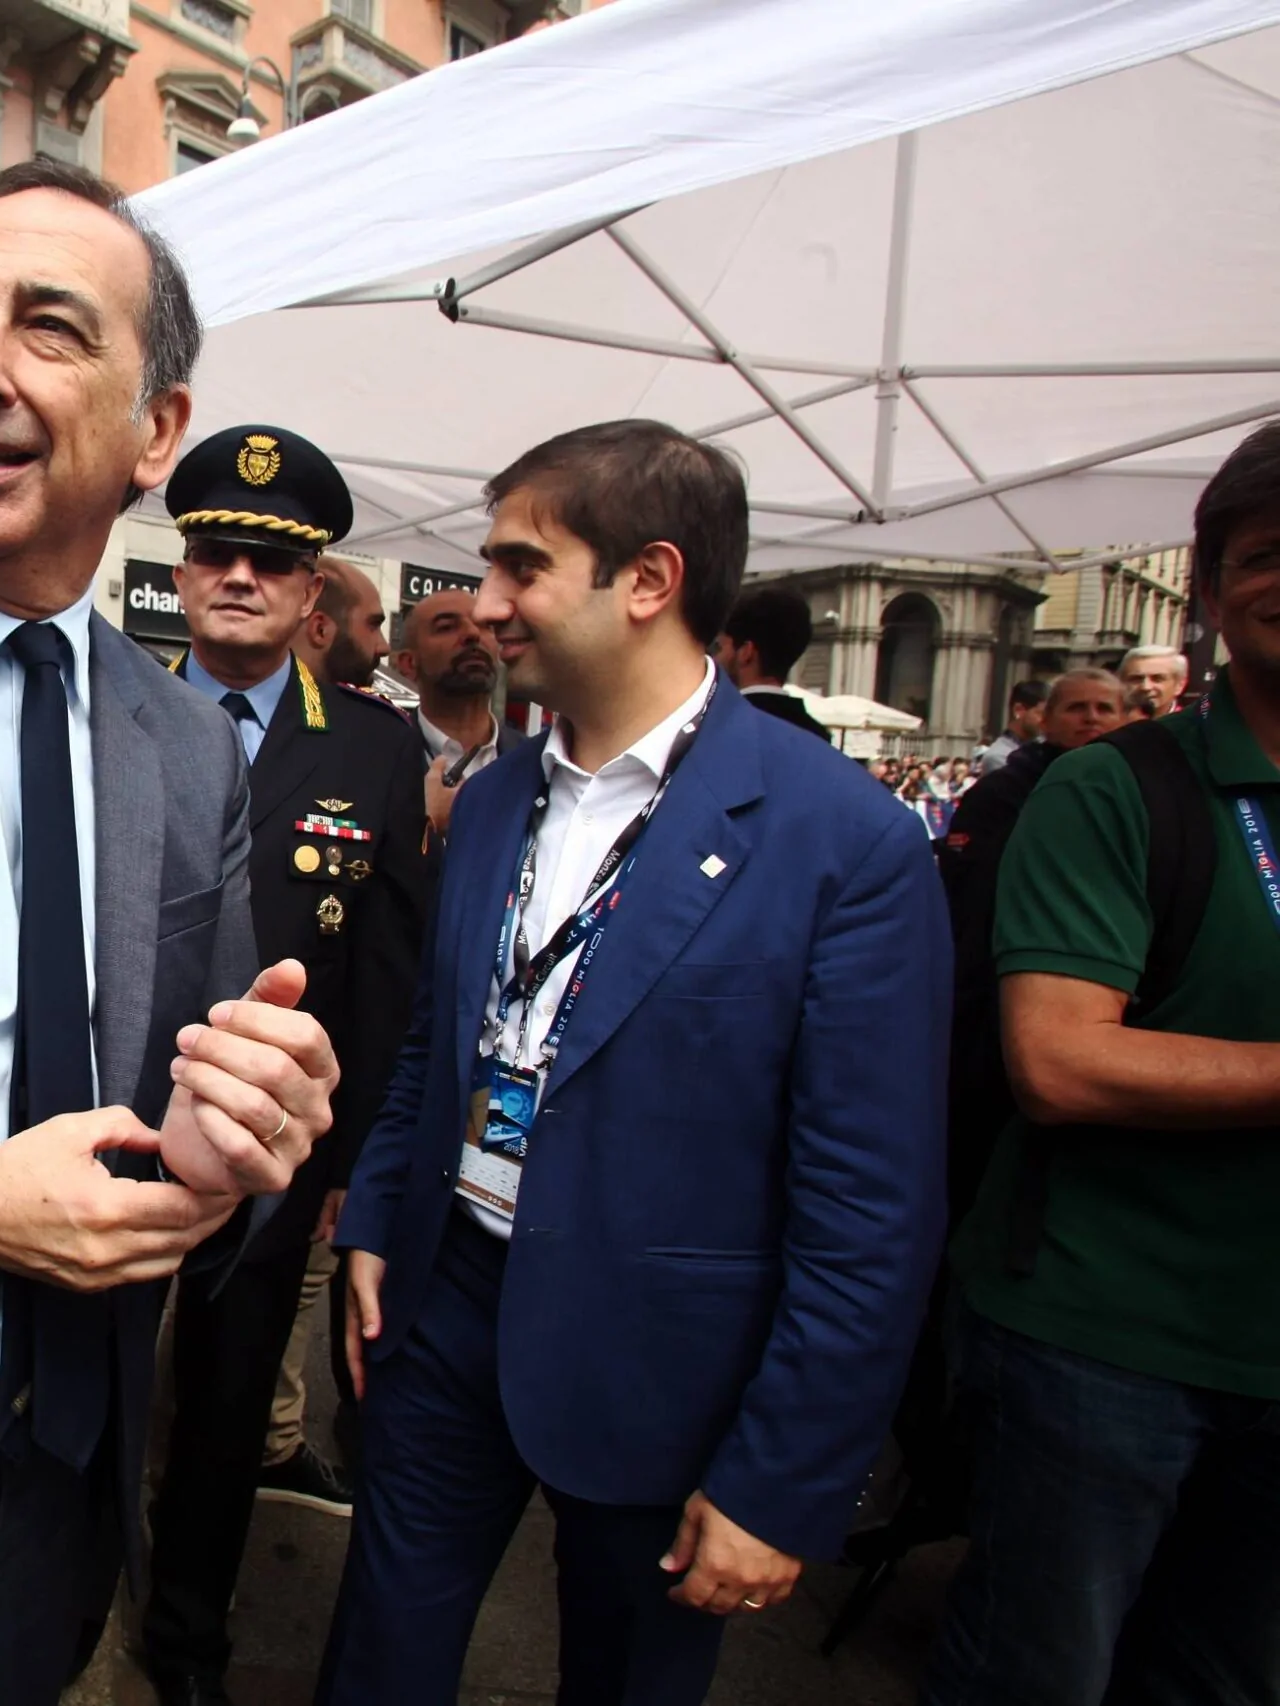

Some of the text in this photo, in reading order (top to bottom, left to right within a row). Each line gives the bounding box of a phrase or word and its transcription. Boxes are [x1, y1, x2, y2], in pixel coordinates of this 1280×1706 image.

[1252, 839, 1274, 880] MIGLIA
[583, 927, 605, 966] 1000
[565, 969, 585, 1011] MIGLIA
[518, 1136, 529, 1157] VIP
